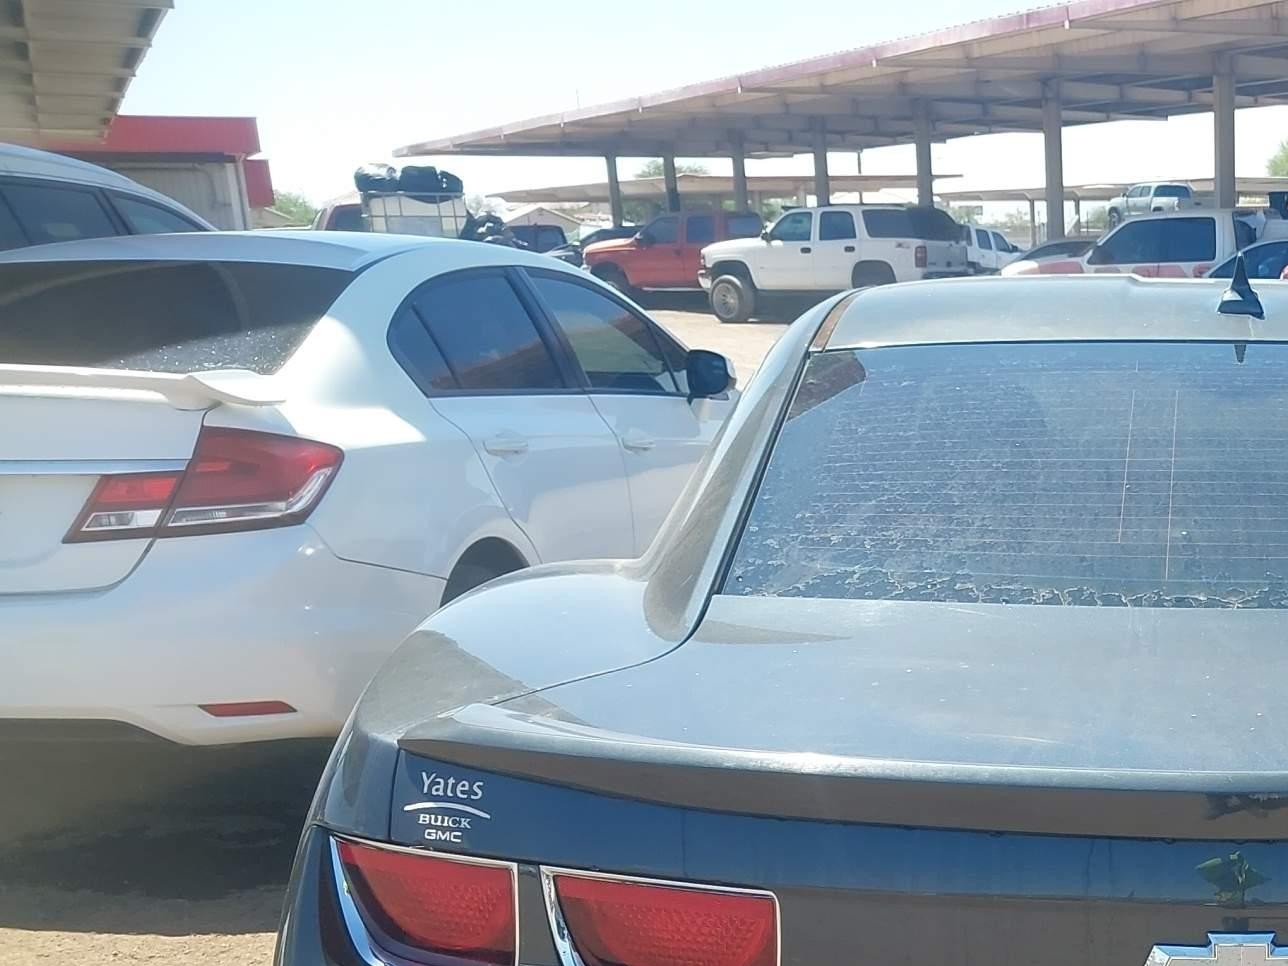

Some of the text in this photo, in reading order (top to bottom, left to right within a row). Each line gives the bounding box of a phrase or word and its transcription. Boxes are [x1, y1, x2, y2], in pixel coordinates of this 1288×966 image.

[421, 771, 484, 800] Yates
[417, 813, 472, 829] BUICK
[424, 829, 463, 843] GMC
